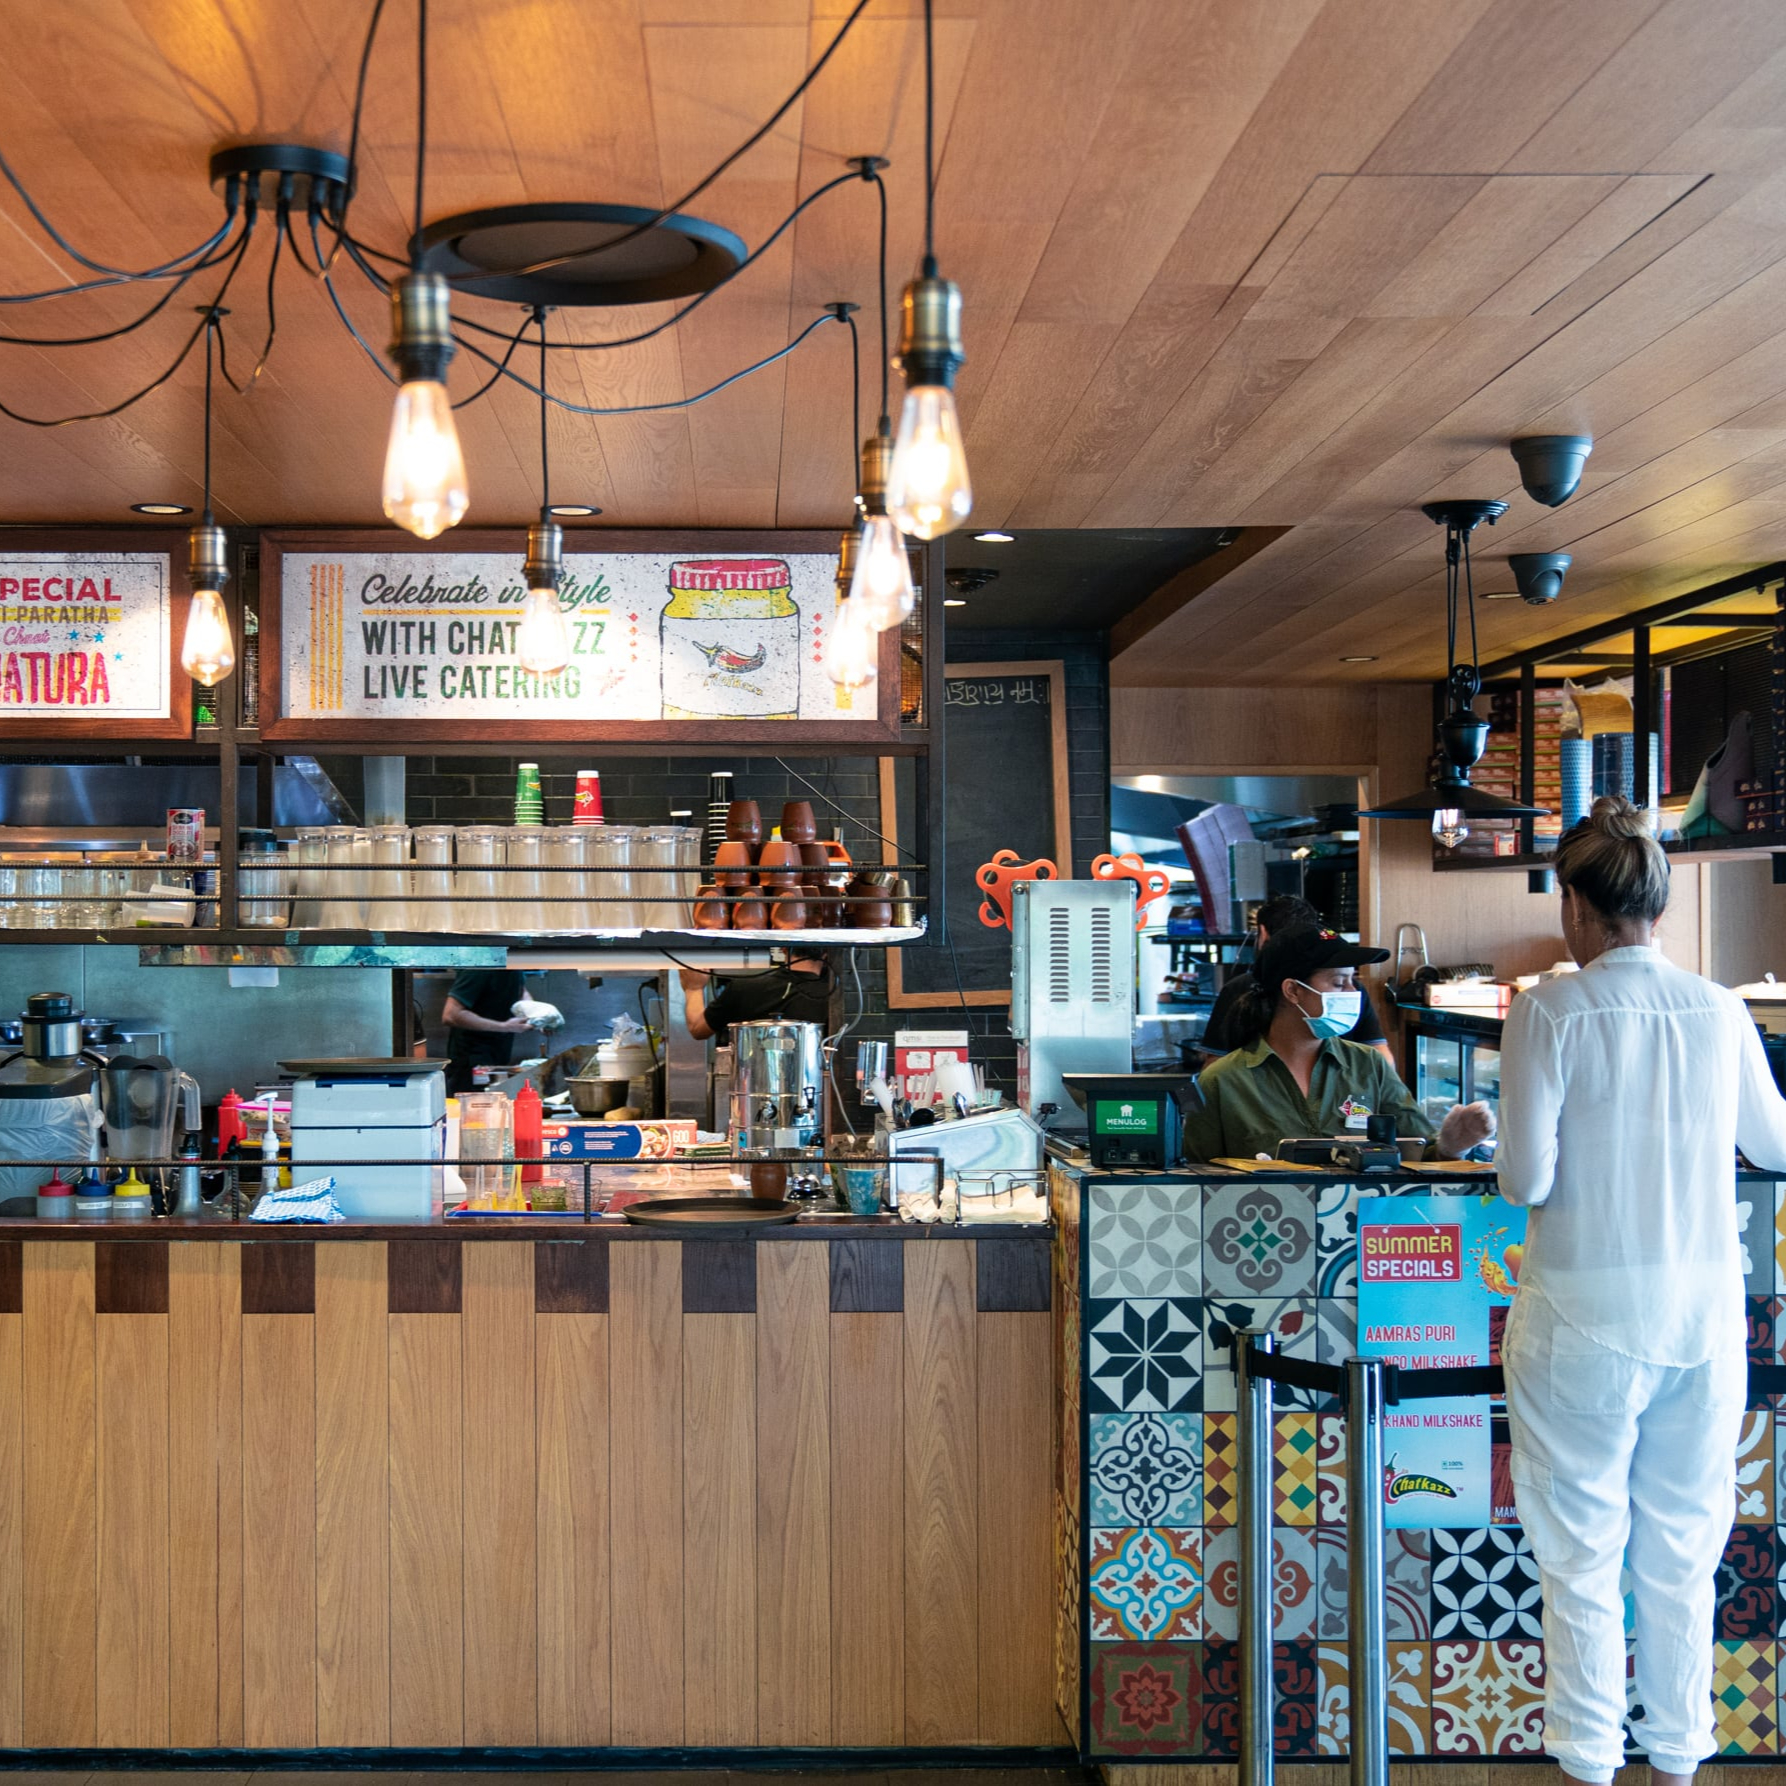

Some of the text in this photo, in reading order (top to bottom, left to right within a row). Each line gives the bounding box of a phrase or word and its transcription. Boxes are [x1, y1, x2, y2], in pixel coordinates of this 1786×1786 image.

[0, 577, 121, 601] PECIAL
[361, 574, 612, 613] Celebrate in tyle
[16, 605, 110, 624] PARATHA
[361, 620, 606, 655] WITH CHATZZ
[0, 651, 110, 706] ATURA
[363, 664, 581, 699] LIVE CATERING
[1106, 1118, 1147, 1126] MENULOG
[673, 1130, 690, 1143] 600
[1366, 1236, 1453, 1254] SUMMER
[1367, 1260, 1454, 1277] SPECIALS
[1366, 1325, 1456, 1342] AAMRAS PURI
[1411, 1354, 1479, 1370] MILKSHAKE
[1384, 1414, 1483, 1428] KHAND MILKSHAKE
[1494, 1507, 1517, 1518] MAN
